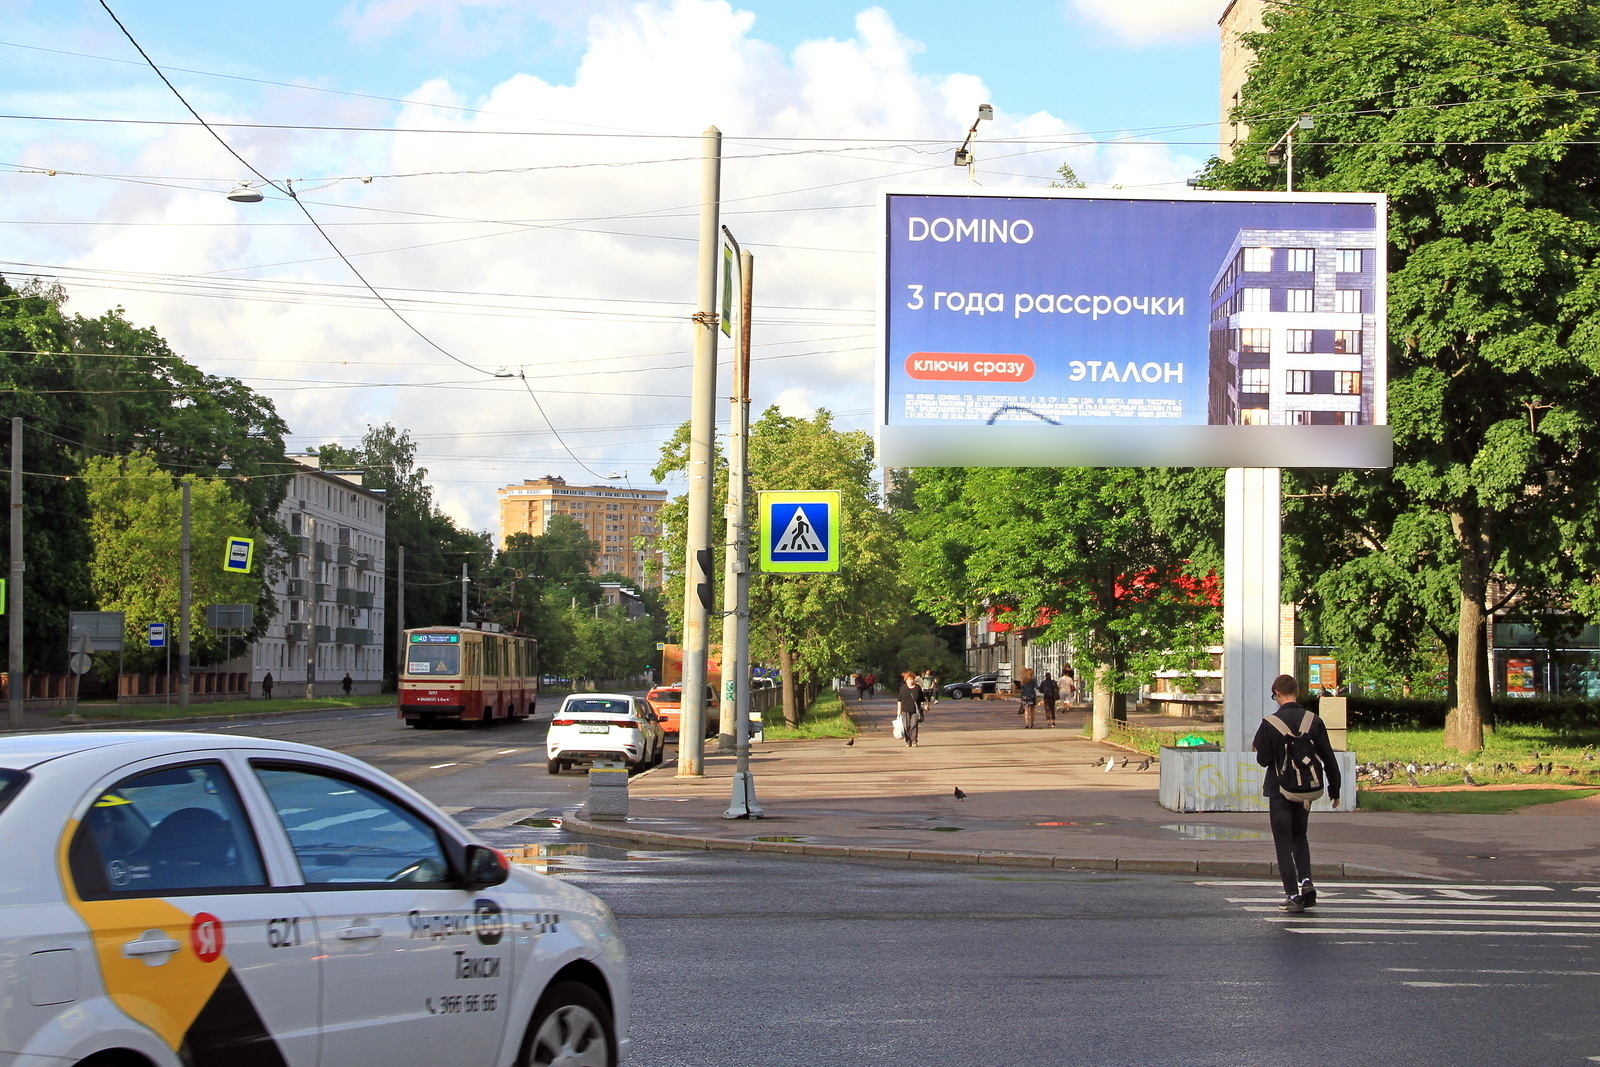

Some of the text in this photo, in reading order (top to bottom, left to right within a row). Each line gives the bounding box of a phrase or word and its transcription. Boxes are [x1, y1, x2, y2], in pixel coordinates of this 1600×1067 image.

[908, 217, 1034, 244] DOMINO
[906, 284, 1184, 320] 3 года рассрочки
[913, 359, 1025, 377] ключи сразу
[1067, 360, 1183, 384] ЭТАЛОН
[197, 920, 217, 955] Я
[266, 916, 301, 949] 621
[407, 909, 471, 941] Яндекс
[453, 950, 501, 979] Такси
[440, 993, 498, 1015] 366 66 66
